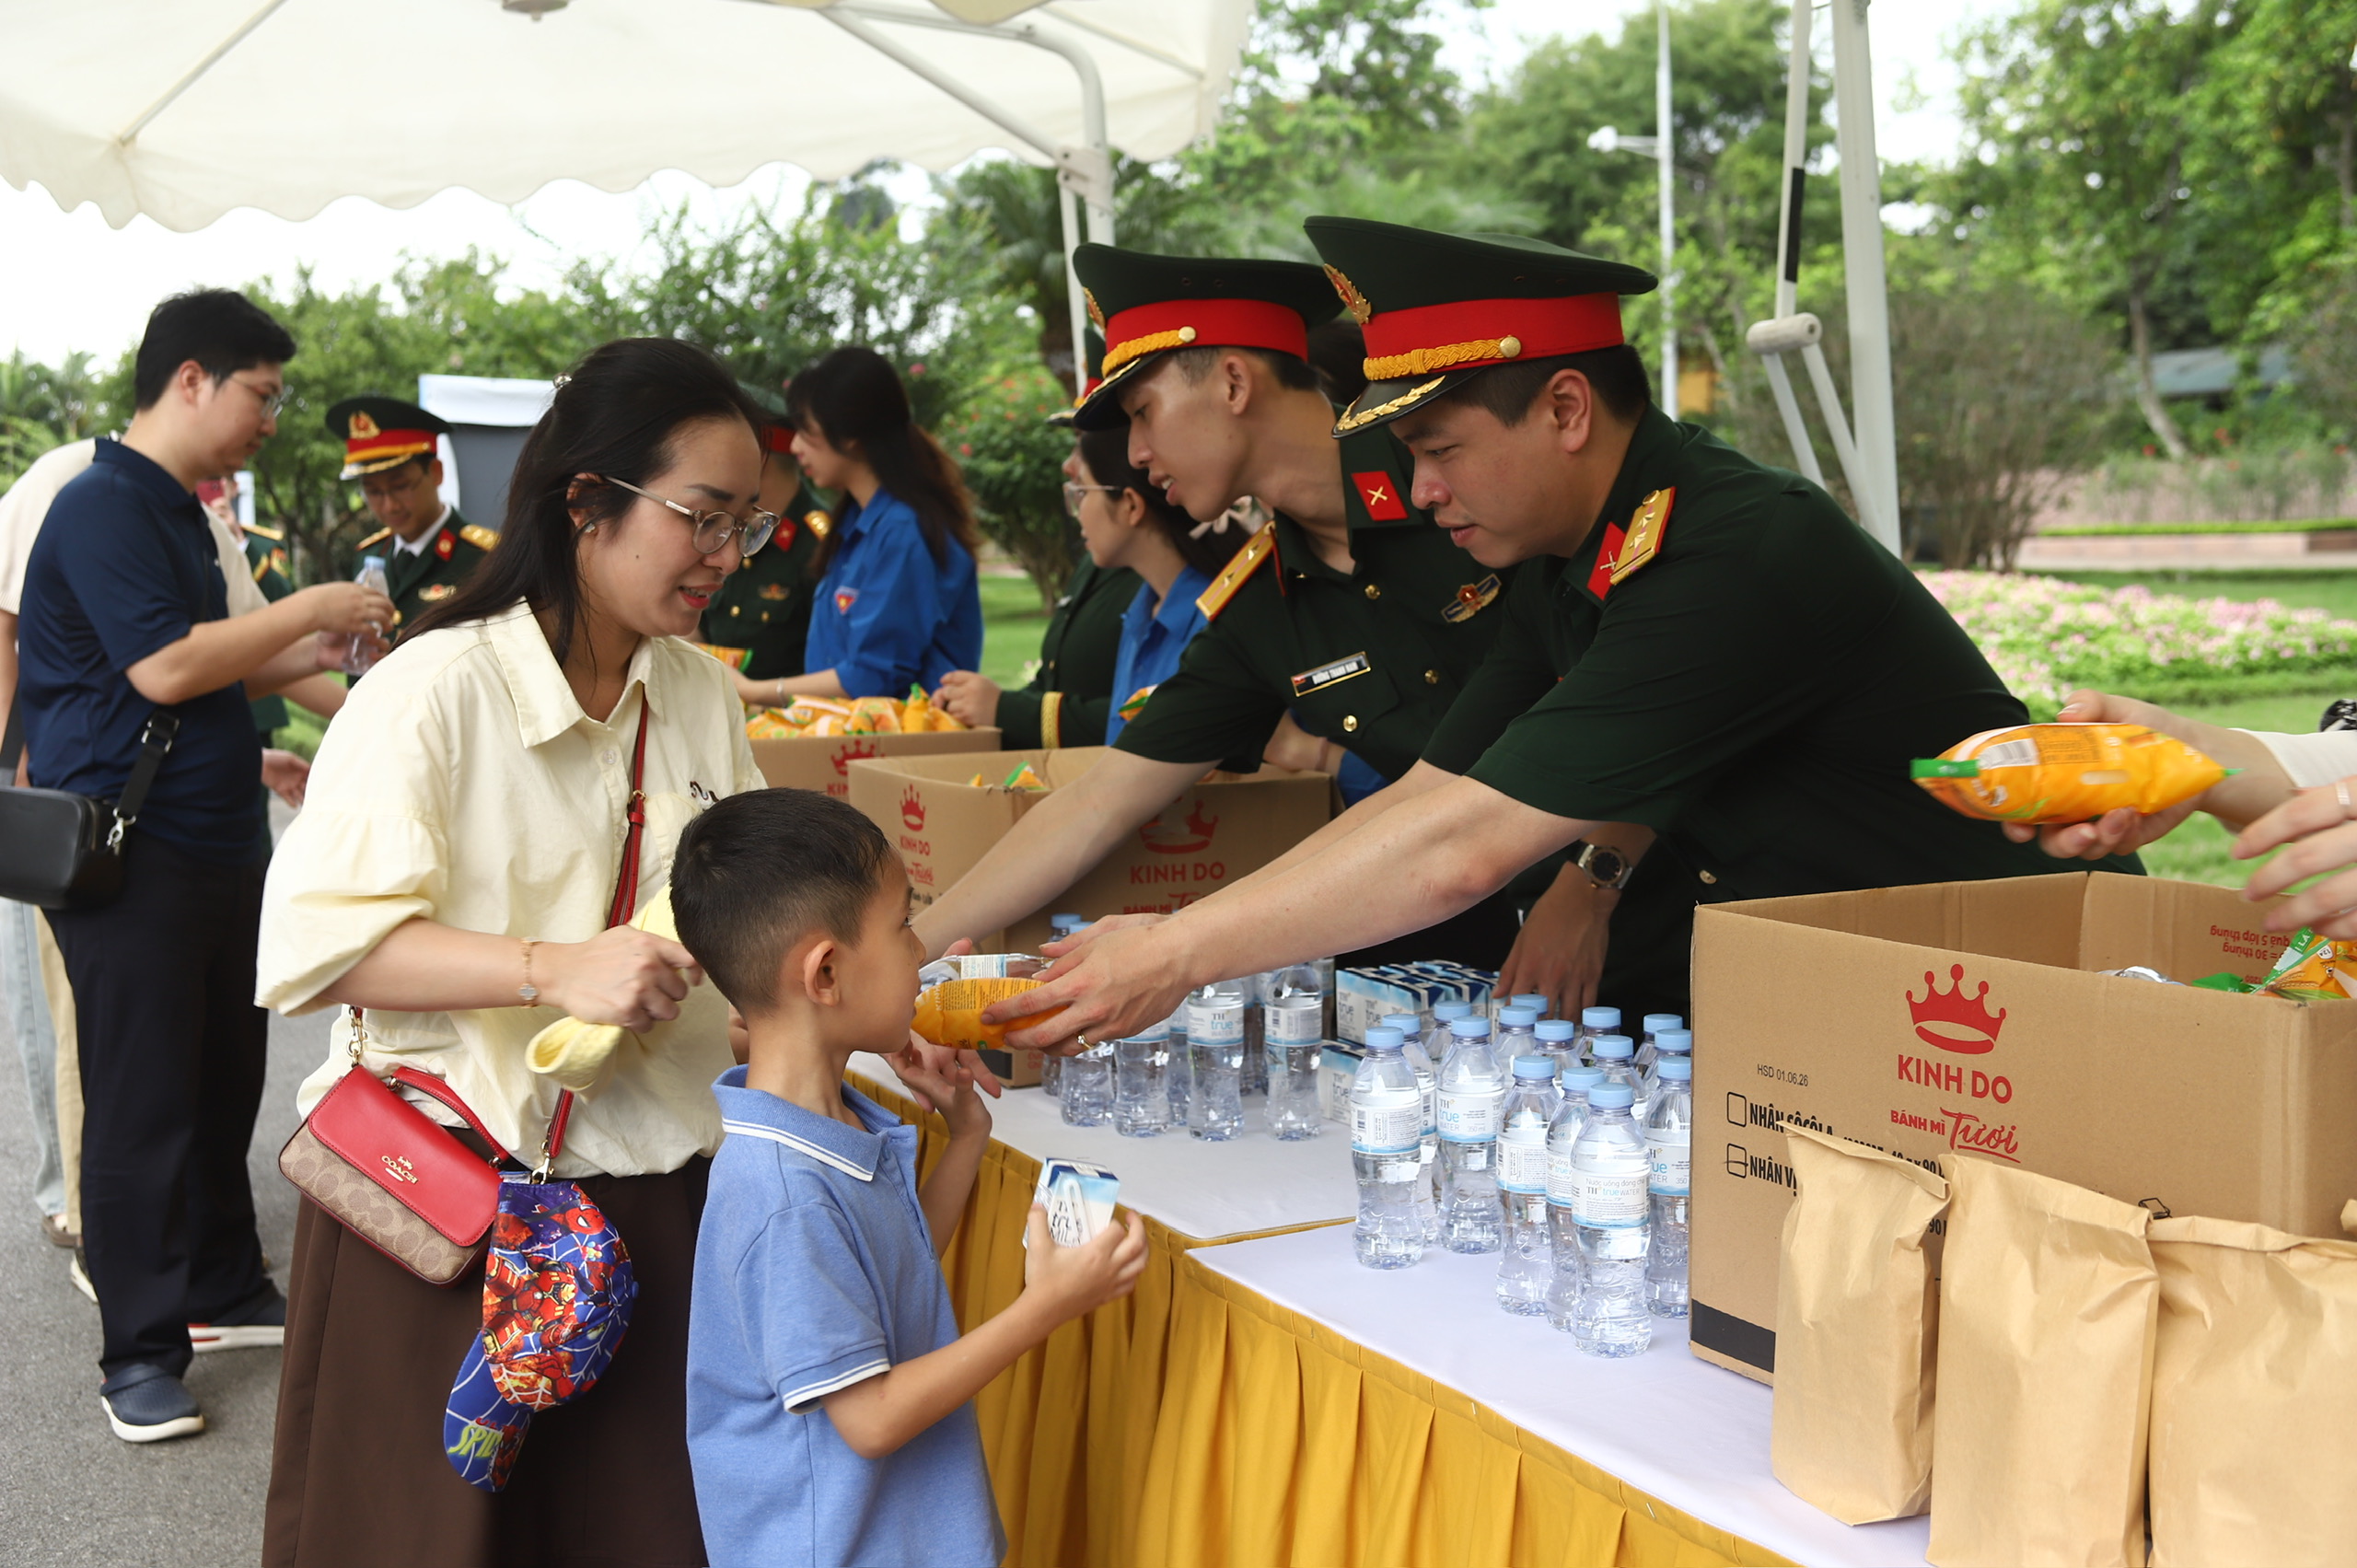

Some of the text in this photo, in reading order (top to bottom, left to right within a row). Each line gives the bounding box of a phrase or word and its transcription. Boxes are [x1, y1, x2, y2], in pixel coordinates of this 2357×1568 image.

[828, 784, 848, 796] KIN
[918, 840, 931, 856] DO
[1130, 861, 1225, 884] KINH DO
[2262, 935, 2268, 947] 5
[2255, 948, 2268, 960] 30
[1211, 1020, 1234, 1030] true
[1757, 1063, 1809, 1087] HSD 01.06.26
[1898, 1054, 2013, 1104] KINH DO
[1439, 1098, 1450, 1109] TH
[1438, 1109, 1460, 1123] true
[1749, 1102, 1784, 1133] NHÂN
[1437, 1123, 1460, 1132] WATER
[1890, 1107, 2018, 1154] BÁNH MÌ Tươi
[381, 1156, 418, 1184] COACH
[1749, 1155, 1782, 1186] NHÂN
[1585, 1178, 1603, 1186] Nước
[1604, 1178, 1620, 1188] uống
[1620, 1178, 1636, 1188] đóng
[1649, 1173, 1688, 1185] ATER 350
[1586, 1186, 1641, 1196] TH true WATER
